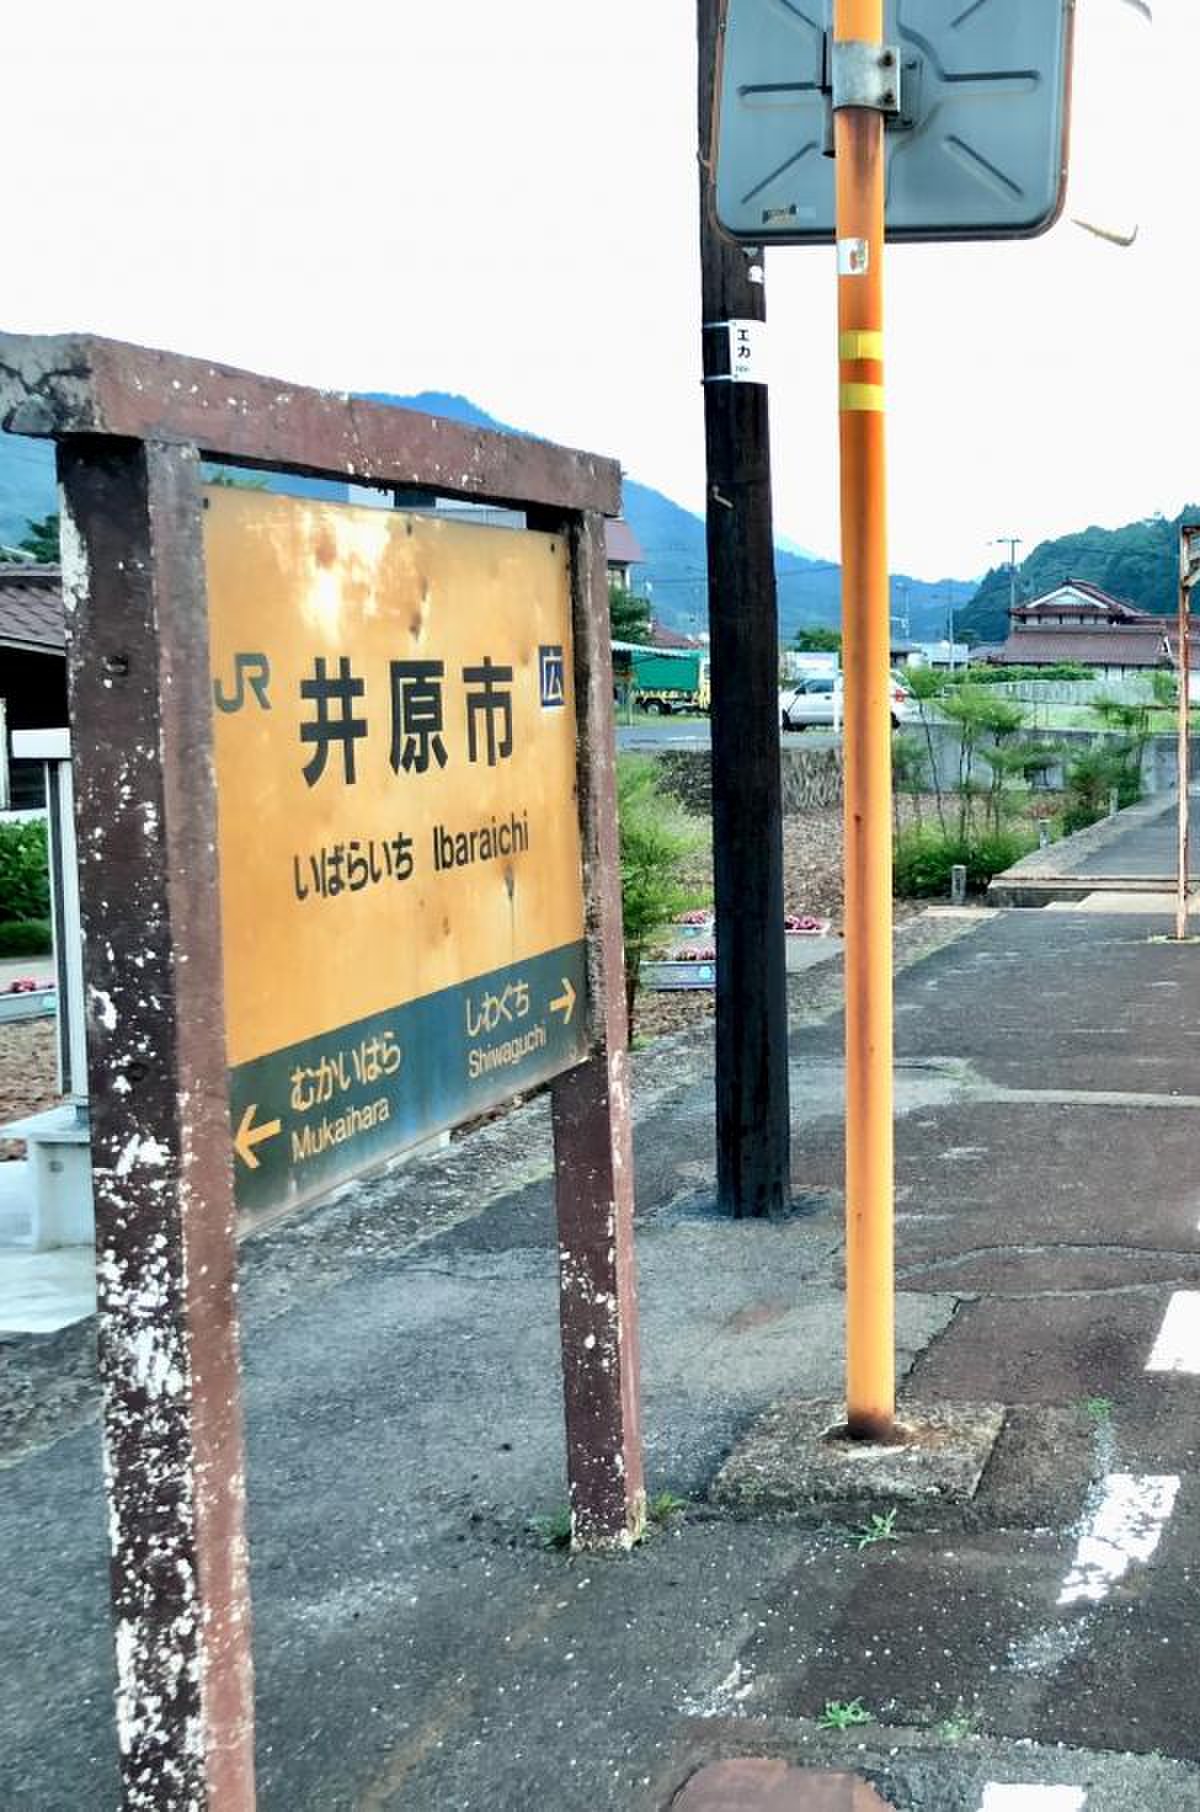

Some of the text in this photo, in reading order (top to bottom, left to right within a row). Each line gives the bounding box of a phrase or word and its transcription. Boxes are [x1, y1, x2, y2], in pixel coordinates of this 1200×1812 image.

[214, 653, 272, 714] JR
[541, 650, 564, 704] 広
[300, 656, 514, 788] 井原市
[294, 809, 530, 901] いばらいち Ibaraichi
[289, 1030, 401, 1112] むかいはら
[468, 1020, 547, 1078] Shiwaguchi
[291, 1097, 391, 1163] Mukaihara
